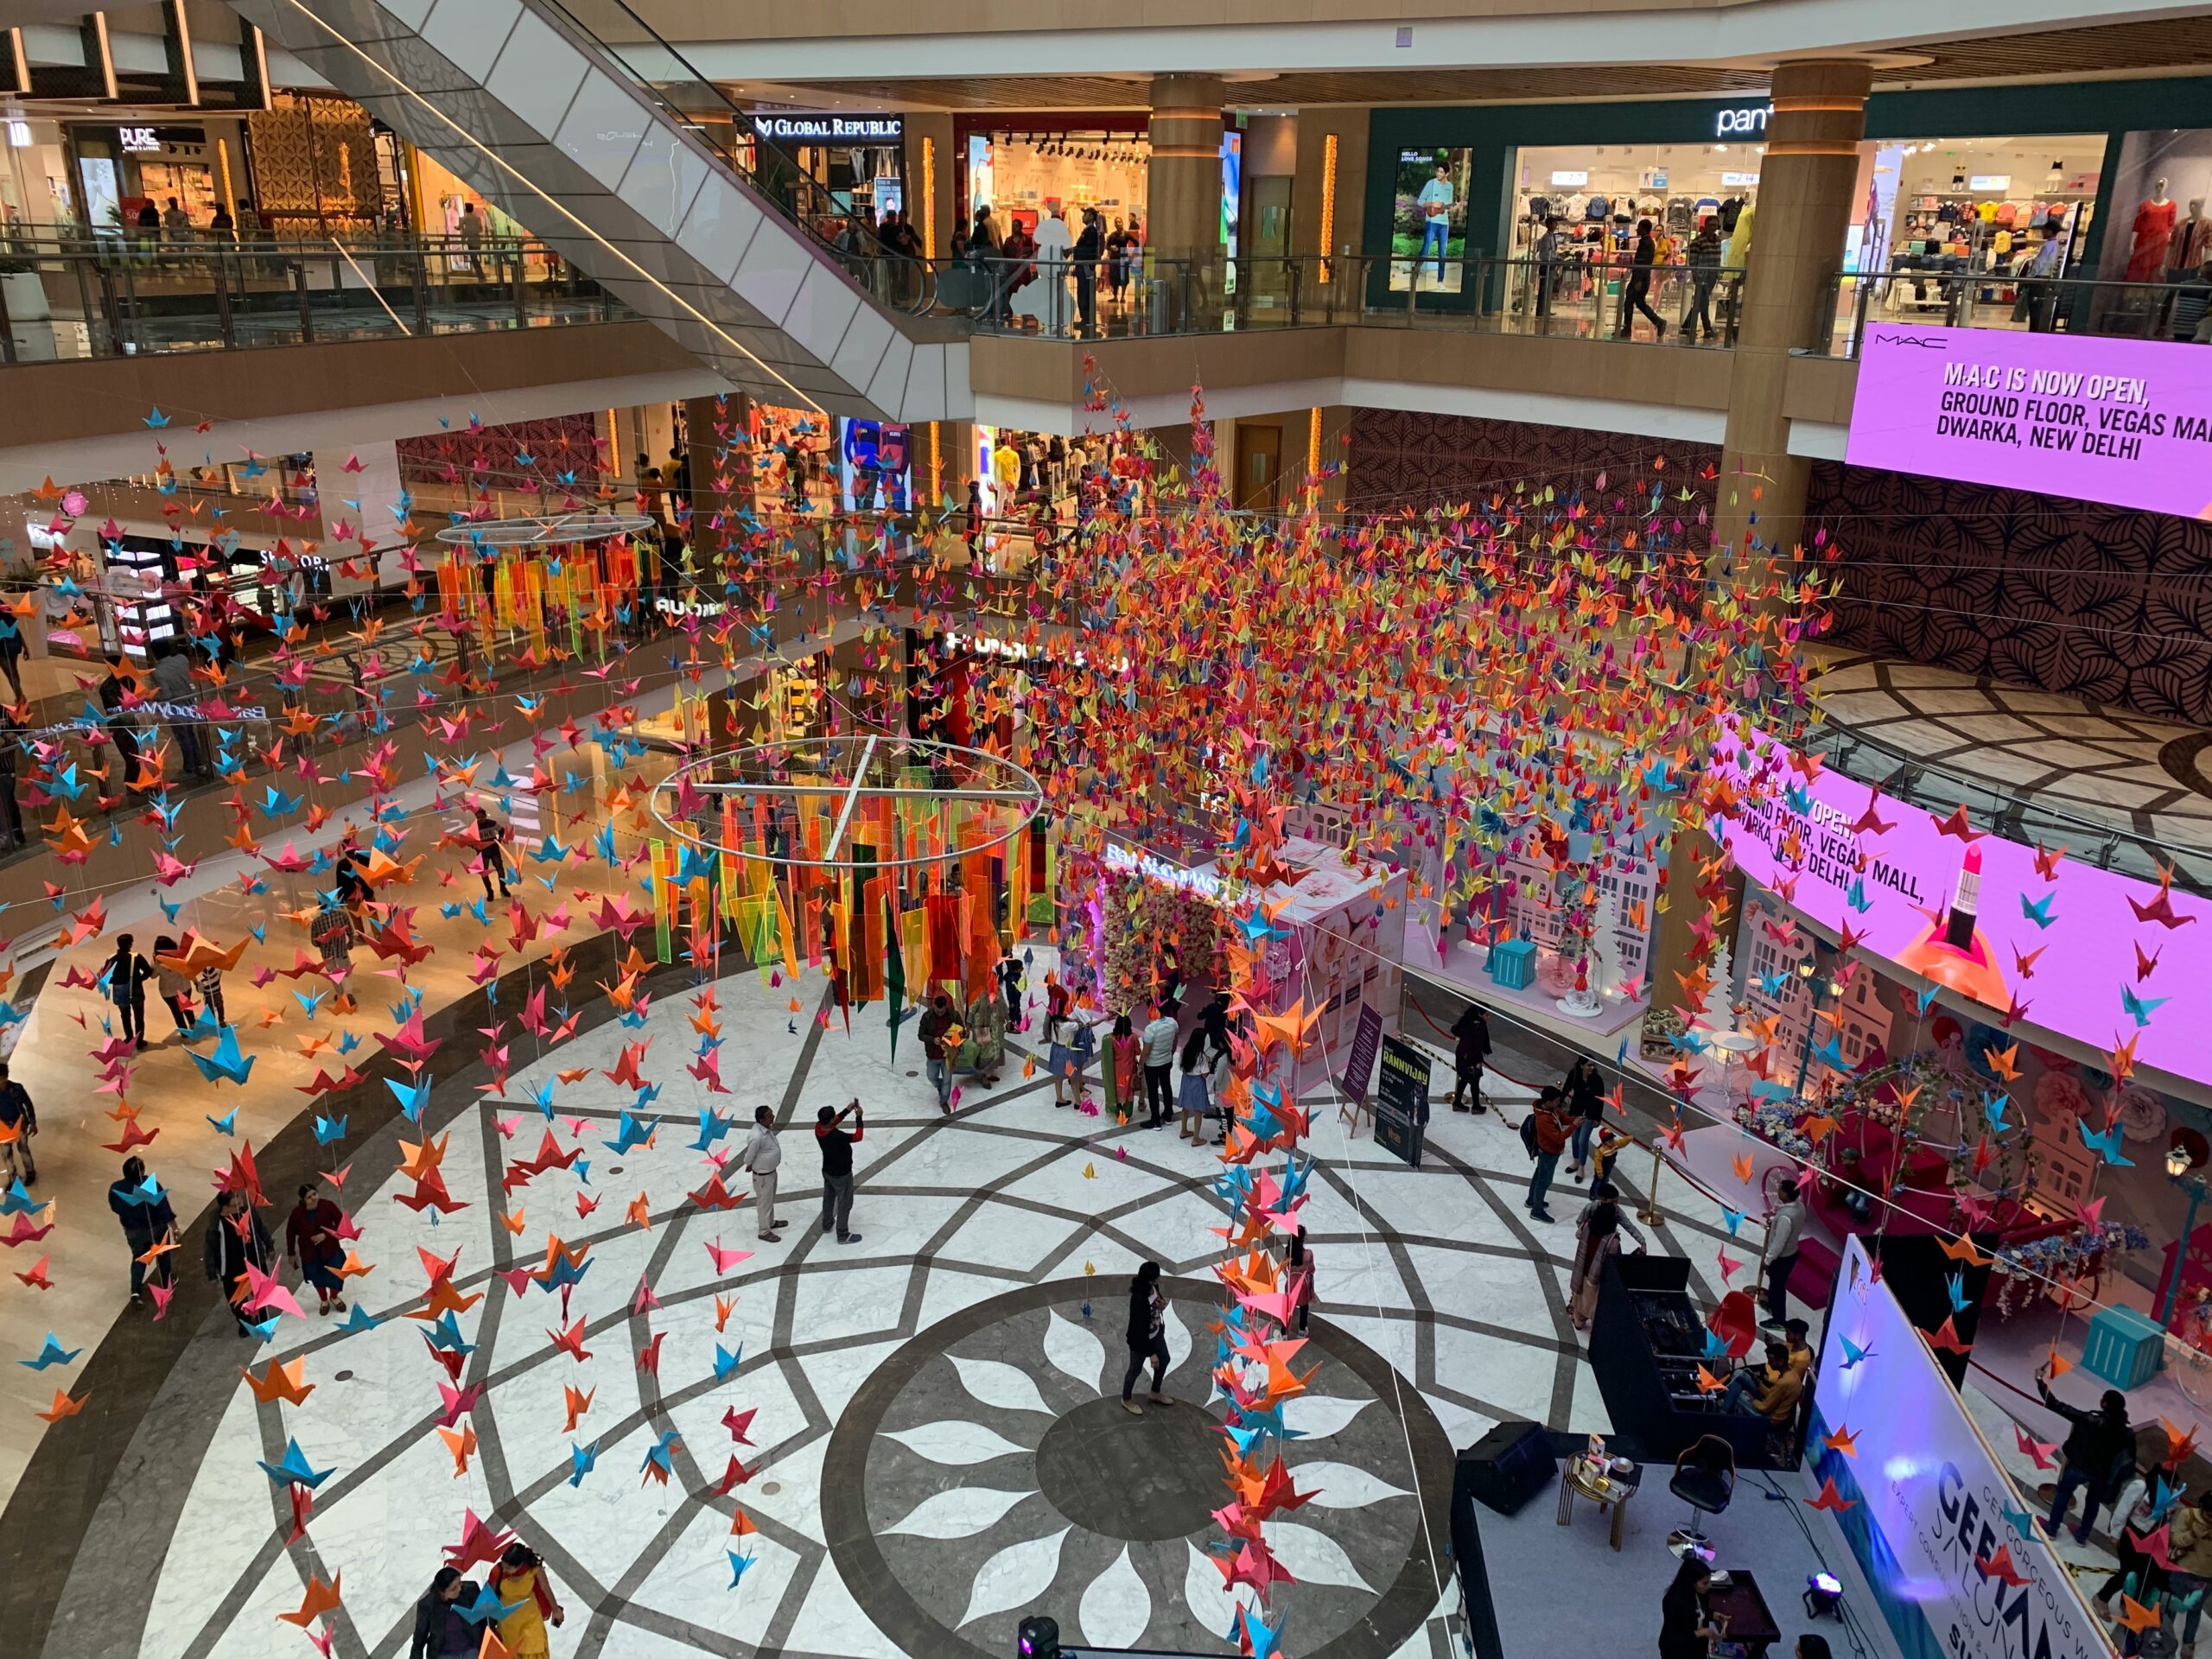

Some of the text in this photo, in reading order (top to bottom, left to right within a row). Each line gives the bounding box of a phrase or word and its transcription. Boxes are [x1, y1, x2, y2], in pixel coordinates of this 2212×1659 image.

[119, 127, 161, 145] PURE
[775, 118, 901, 135] GLOBAL REPUBLIC
[2005, 366, 2028, 392] IS
[2031, 370, 2084, 398] NOW
[2087, 374, 2150, 410] OPEN,
[1941, 391, 2019, 418] GROUND
[2024, 399, 2089, 431] FLOOR,
[2099, 407, 2167, 436] VEGAS
[1936, 415, 2142, 461] DWARKA, NEW DELHI
[1736, 779, 1773, 820] GRND
[1776, 807, 1815, 852] FOOR,
[1820, 831, 1866, 874] VEGA
[1872, 860, 1925, 905] MALL,
[1812, 800, 1856, 847] OPEN,
[1808, 855, 1851, 892] DELHI
[1383, 1050, 1428, 1086] RANNVIJAY
[1891, 1480, 1918, 1529] EXPERT
[1983, 1486, 2004, 1522] GET
[2005, 1524, 2072, 1639] GORGEOUS
